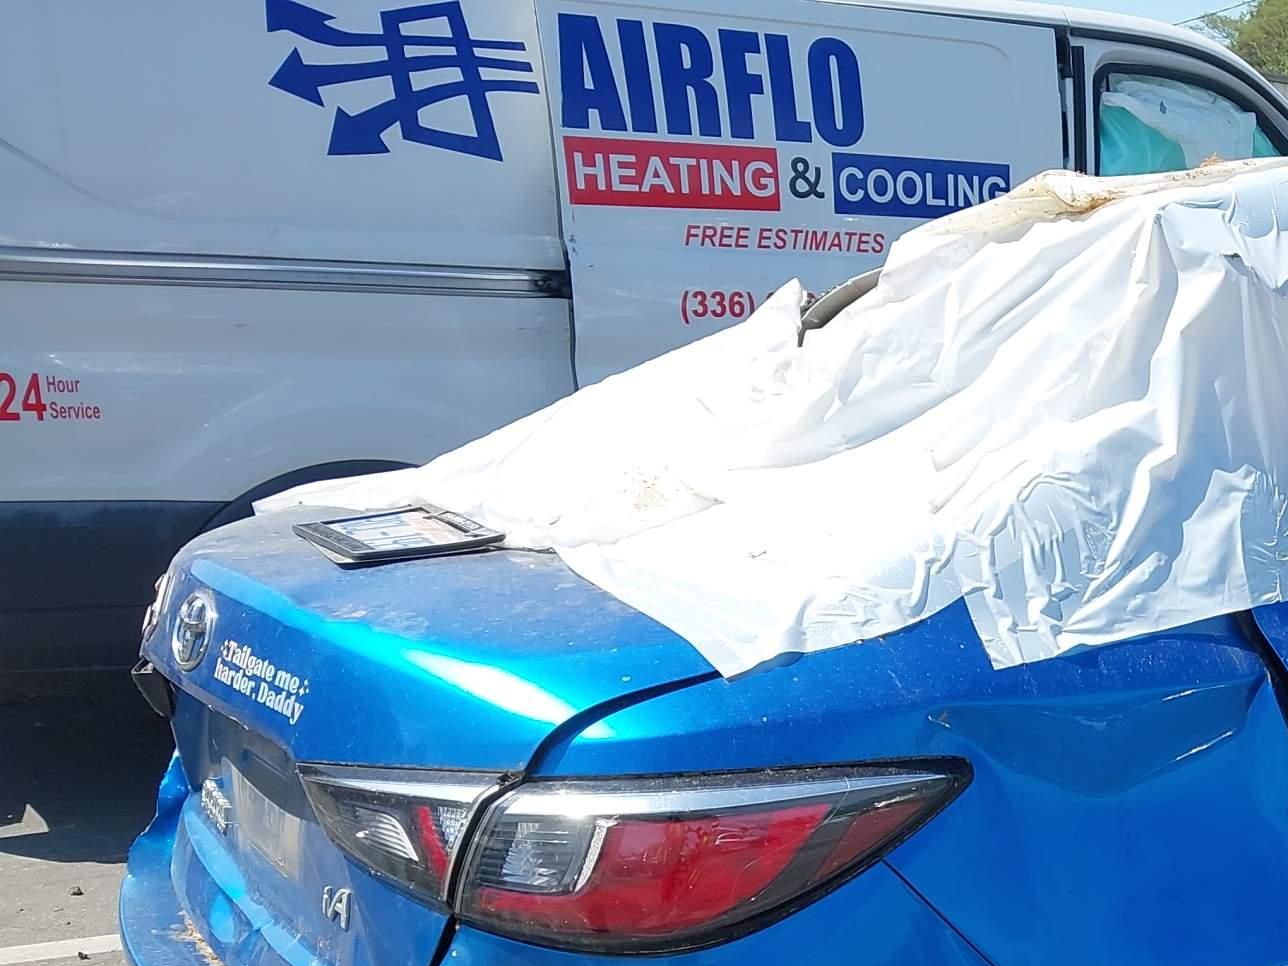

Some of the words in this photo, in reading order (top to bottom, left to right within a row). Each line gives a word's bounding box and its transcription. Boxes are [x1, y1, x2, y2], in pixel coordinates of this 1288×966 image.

[557, 13, 864, 148] AIRFLO
[572, 151, 776, 198] HEATING
[788, 156, 825, 200] &
[838, 166, 1008, 208] COOLING
[684, 224, 750, 249] FREE
[757, 227, 885, 254] ESTIMATES
[681, 290, 755, 325] (336)
[0, 373, 47, 421] 24
[46, 375, 80, 393] Hour
[49, 401, 101, 420] Service
[223, 640, 275, 682] Tailgate
[274, 670, 300, 693] me
[257, 682, 304, 725] Daddy
